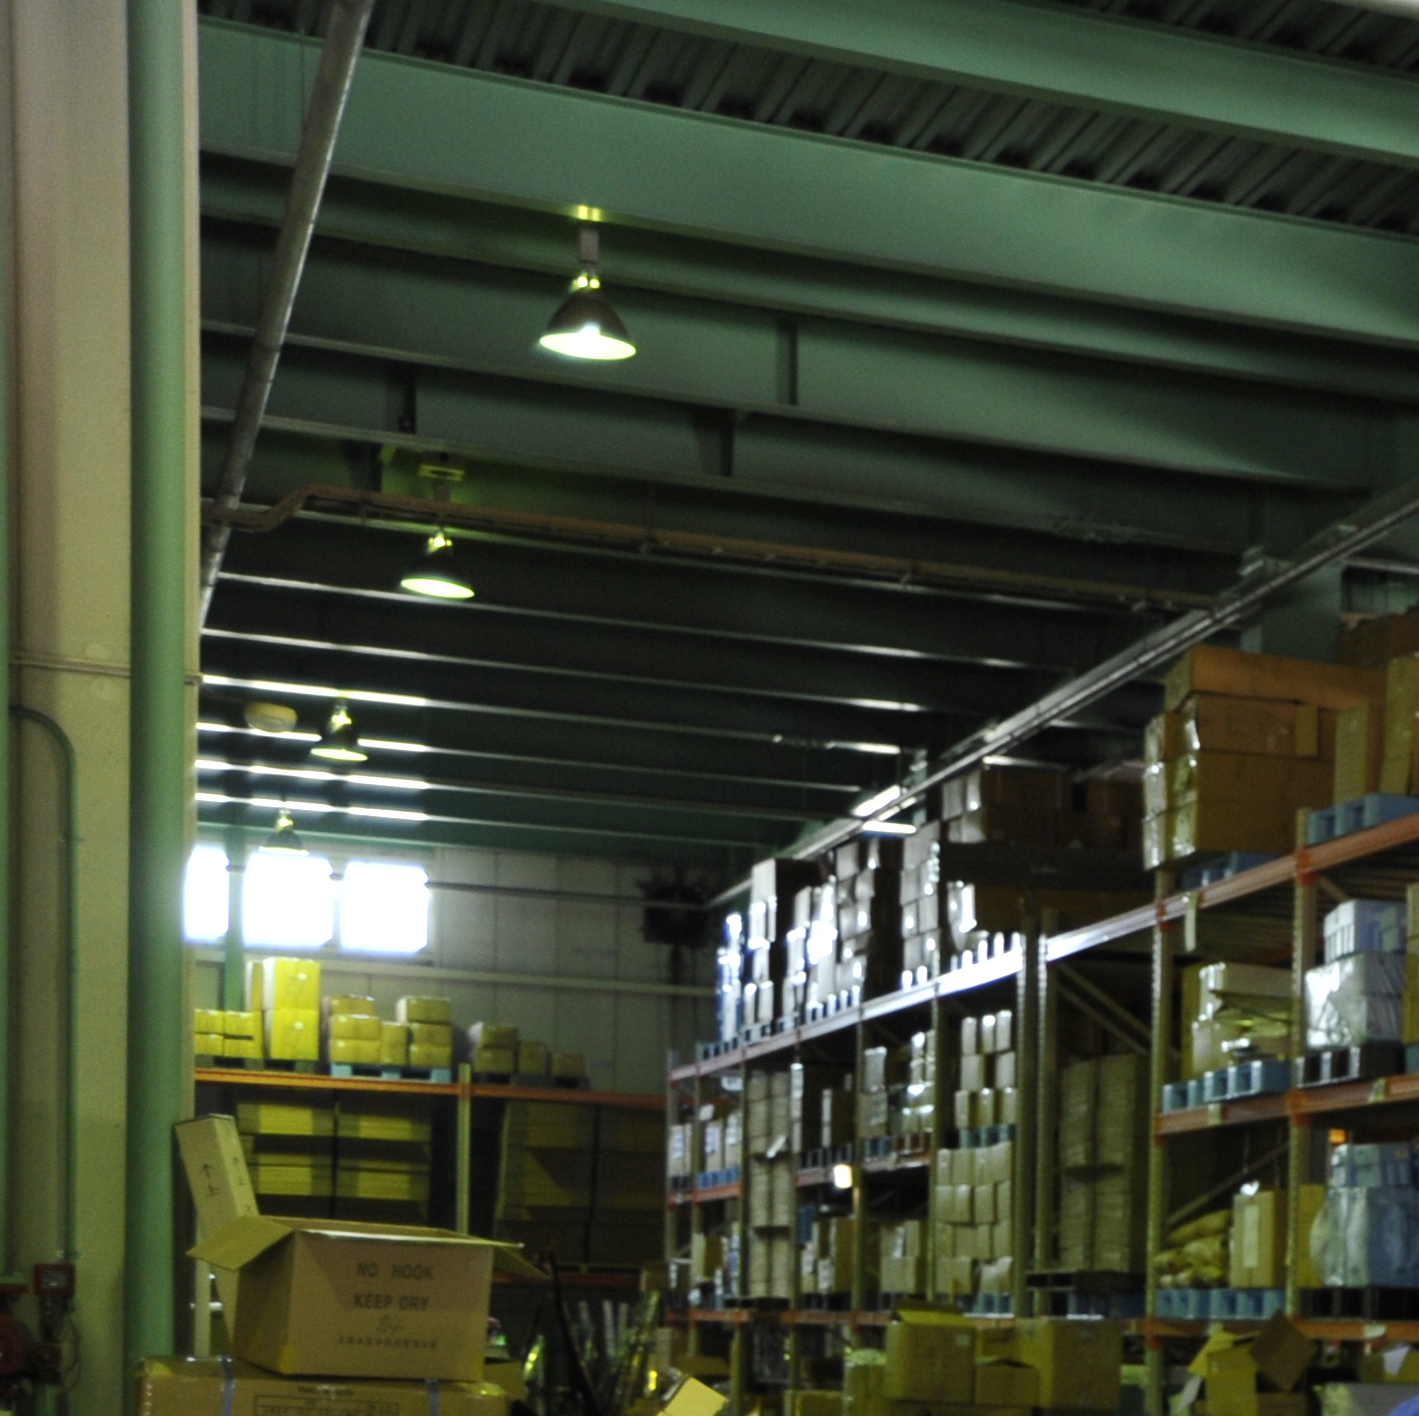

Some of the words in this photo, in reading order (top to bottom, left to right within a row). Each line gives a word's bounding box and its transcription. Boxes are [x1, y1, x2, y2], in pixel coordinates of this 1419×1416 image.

[357, 1262, 378, 1278] NO
[391, 1264, 434, 1281] HOOK
[354, 1293, 394, 1309] KEEP
[398, 1293, 430, 1310] DRY
